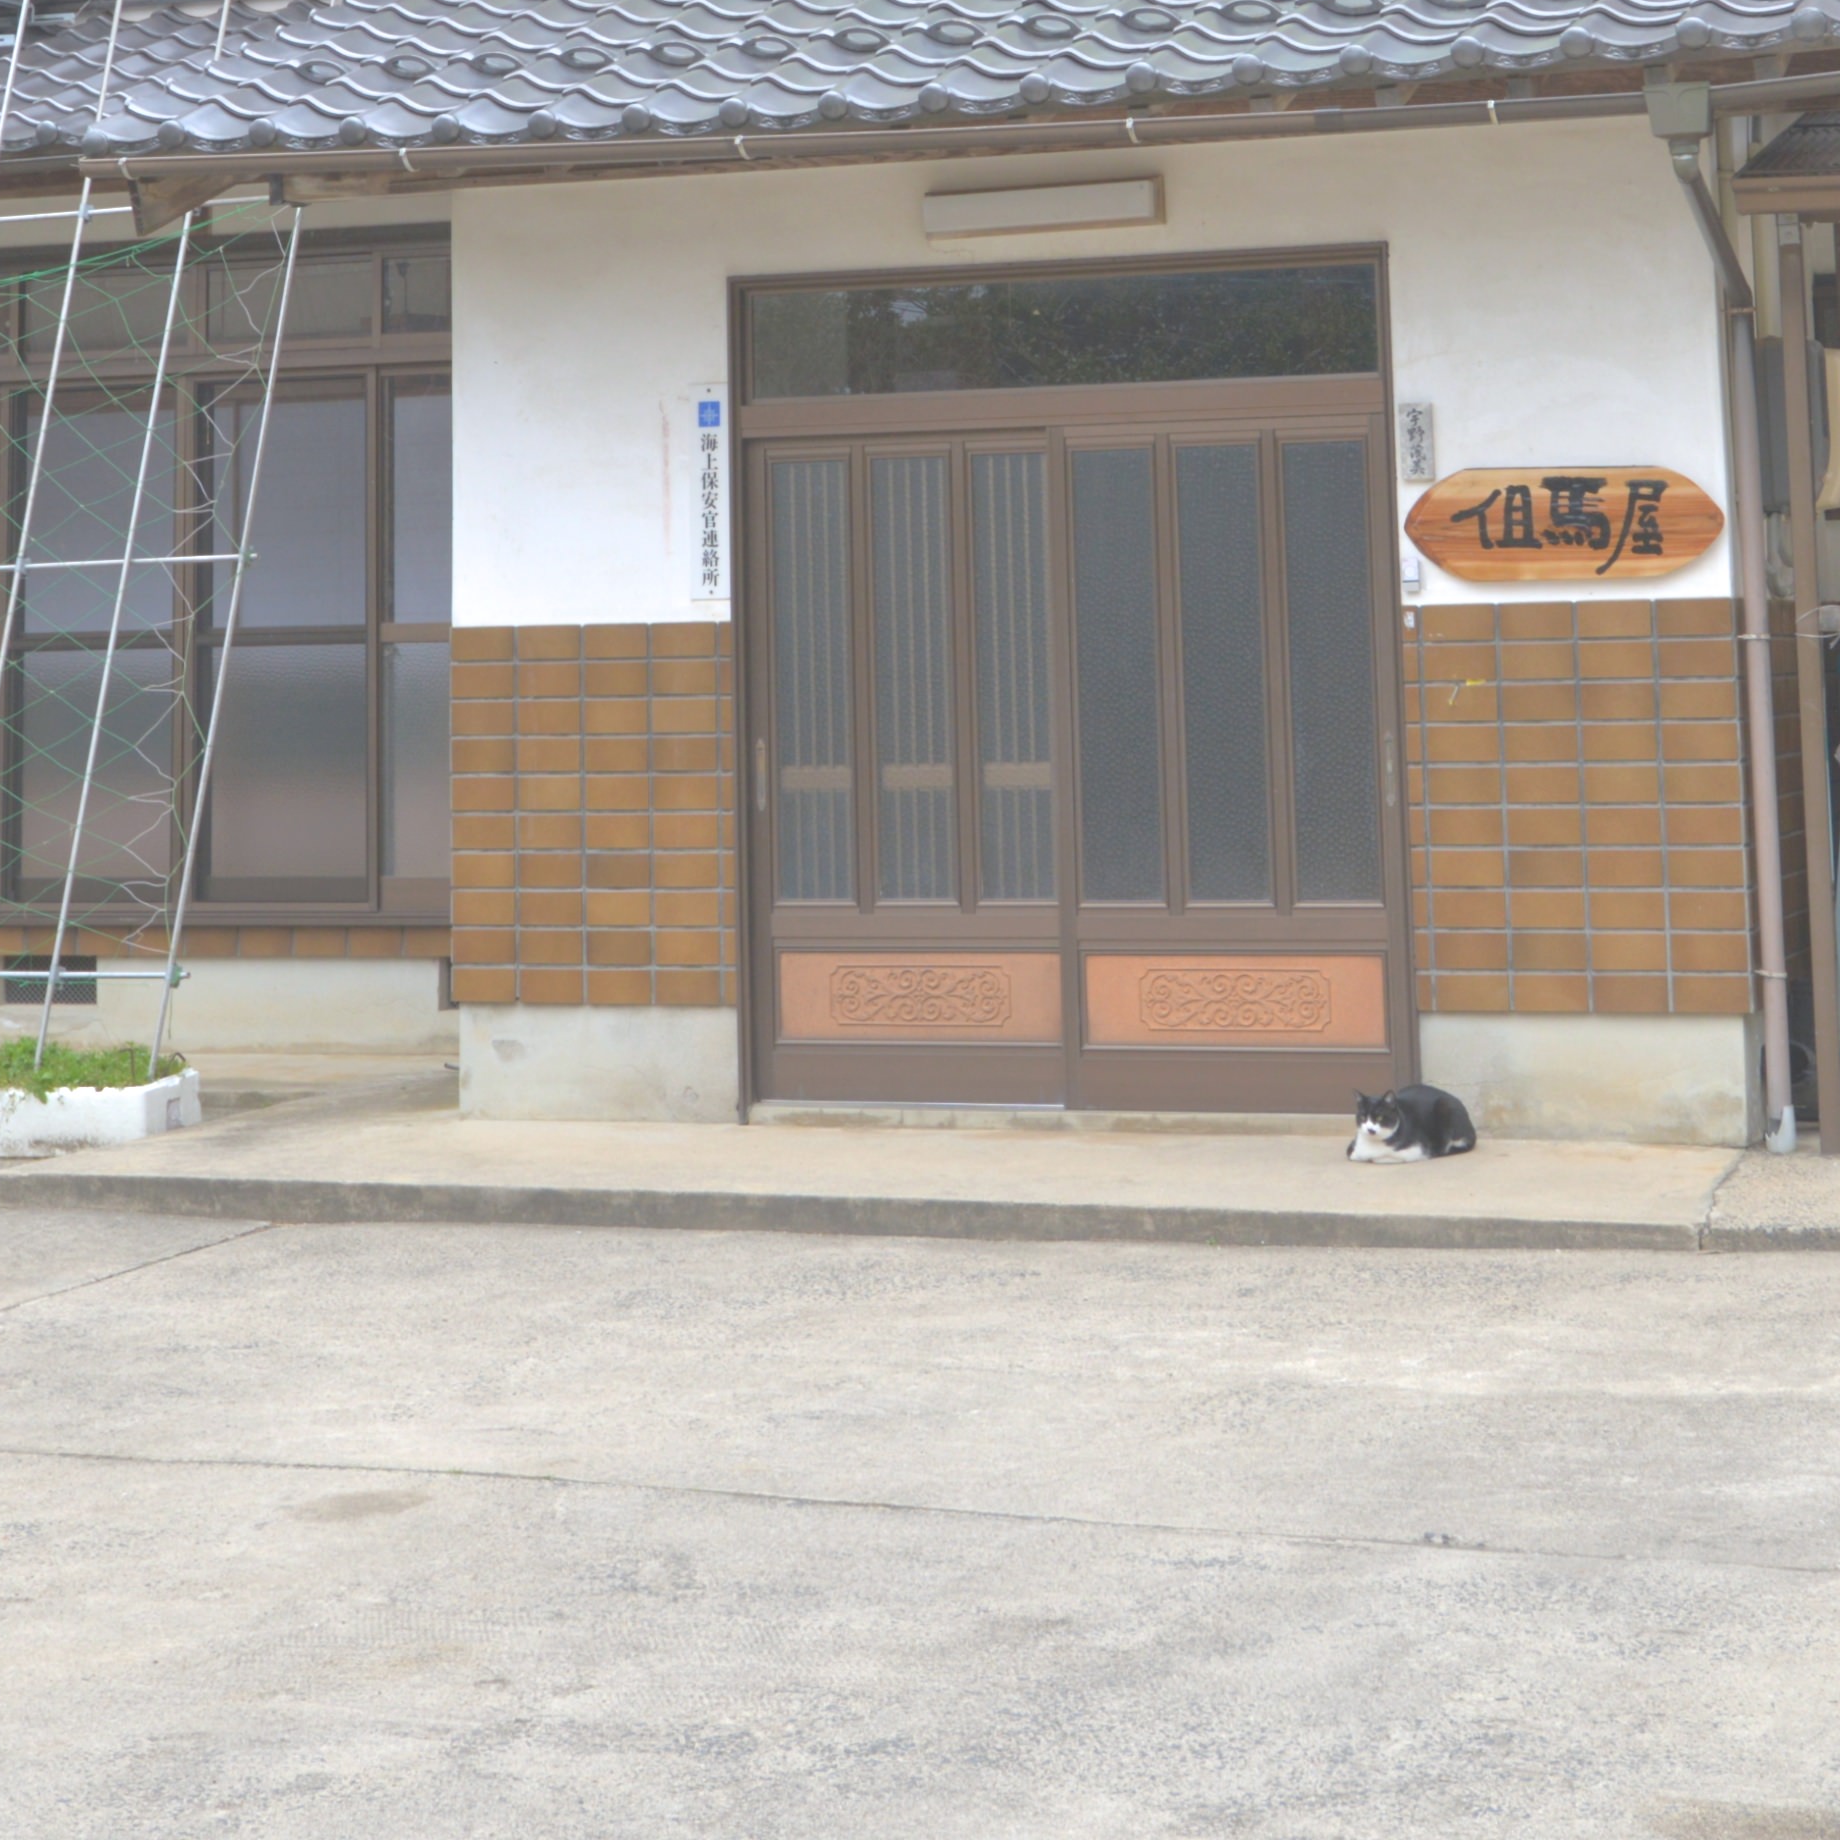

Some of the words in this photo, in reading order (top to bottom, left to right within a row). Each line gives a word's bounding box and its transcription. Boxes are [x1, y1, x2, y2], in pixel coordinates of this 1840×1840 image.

[701, 433, 720, 587] 海上保安官連絡所
